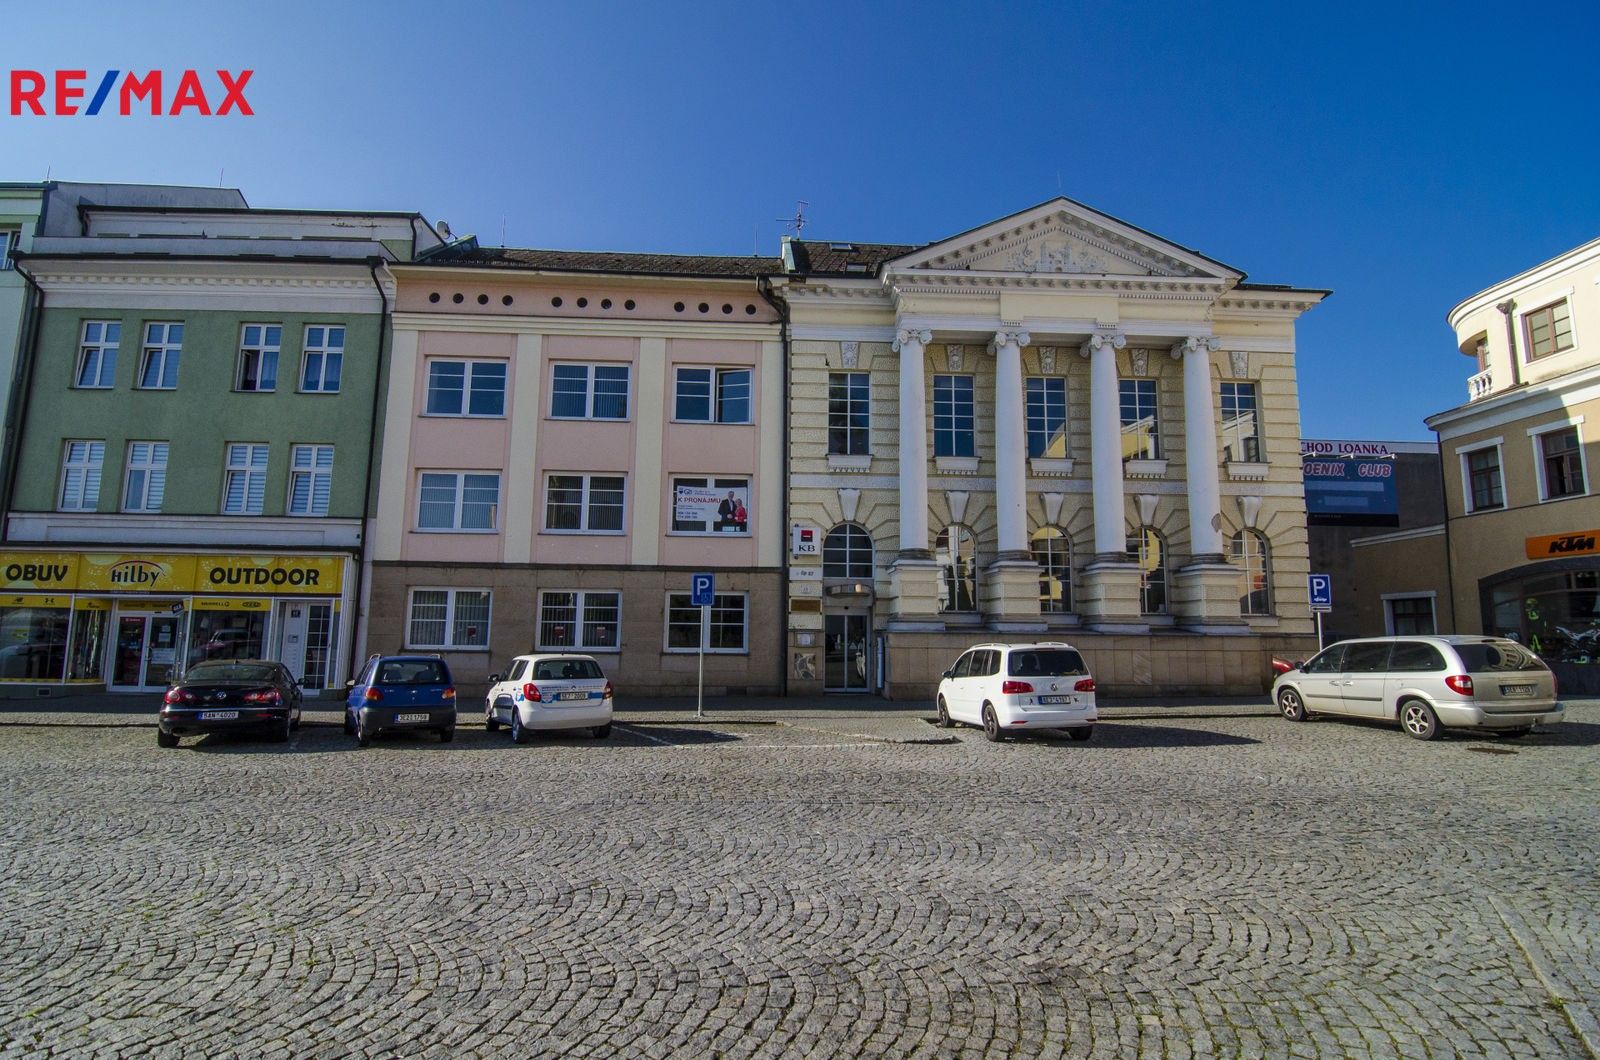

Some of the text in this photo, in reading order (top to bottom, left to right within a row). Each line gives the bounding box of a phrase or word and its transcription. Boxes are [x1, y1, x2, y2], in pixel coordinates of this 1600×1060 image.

[1338, 443, 1388, 455] LOANKA
[1358, 463, 1392, 478] CLUB
[798, 544, 816, 552] KB
[1548, 535, 1595, 553] KTM
[5, 564, 68, 582] OBUV
[209, 567, 320, 585] OUTDOOR
[697, 578, 710, 596] P
[1312, 578, 1326, 596] P
